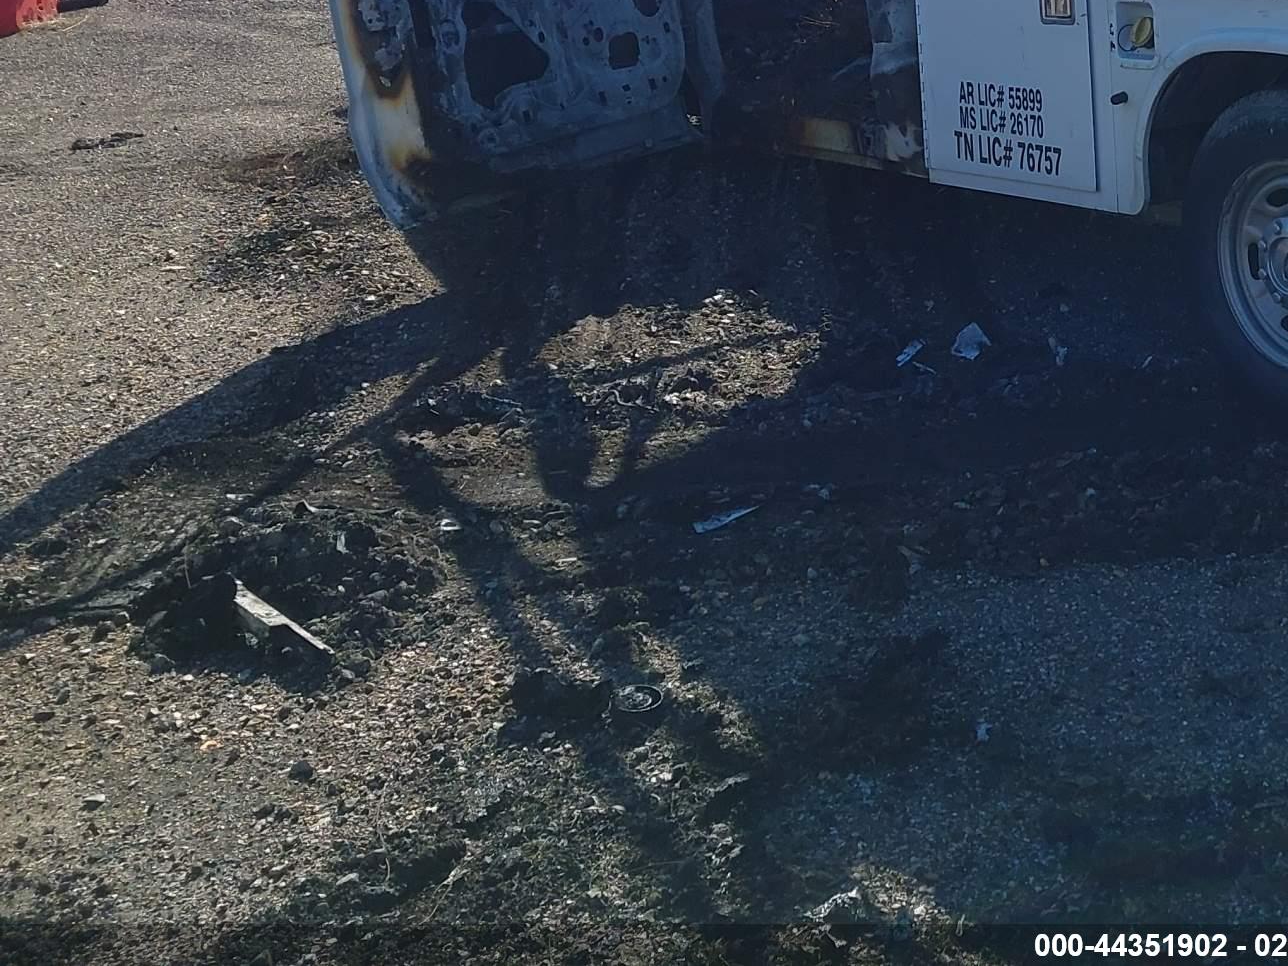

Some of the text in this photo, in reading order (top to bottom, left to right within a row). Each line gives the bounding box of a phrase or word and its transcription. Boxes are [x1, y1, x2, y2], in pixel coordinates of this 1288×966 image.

[959, 81, 1043, 113] AR LIC# 55899
[959, 105, 1044, 139] MS LIC# 26170
[953, 130, 1063, 176] TN LIC# 76757
